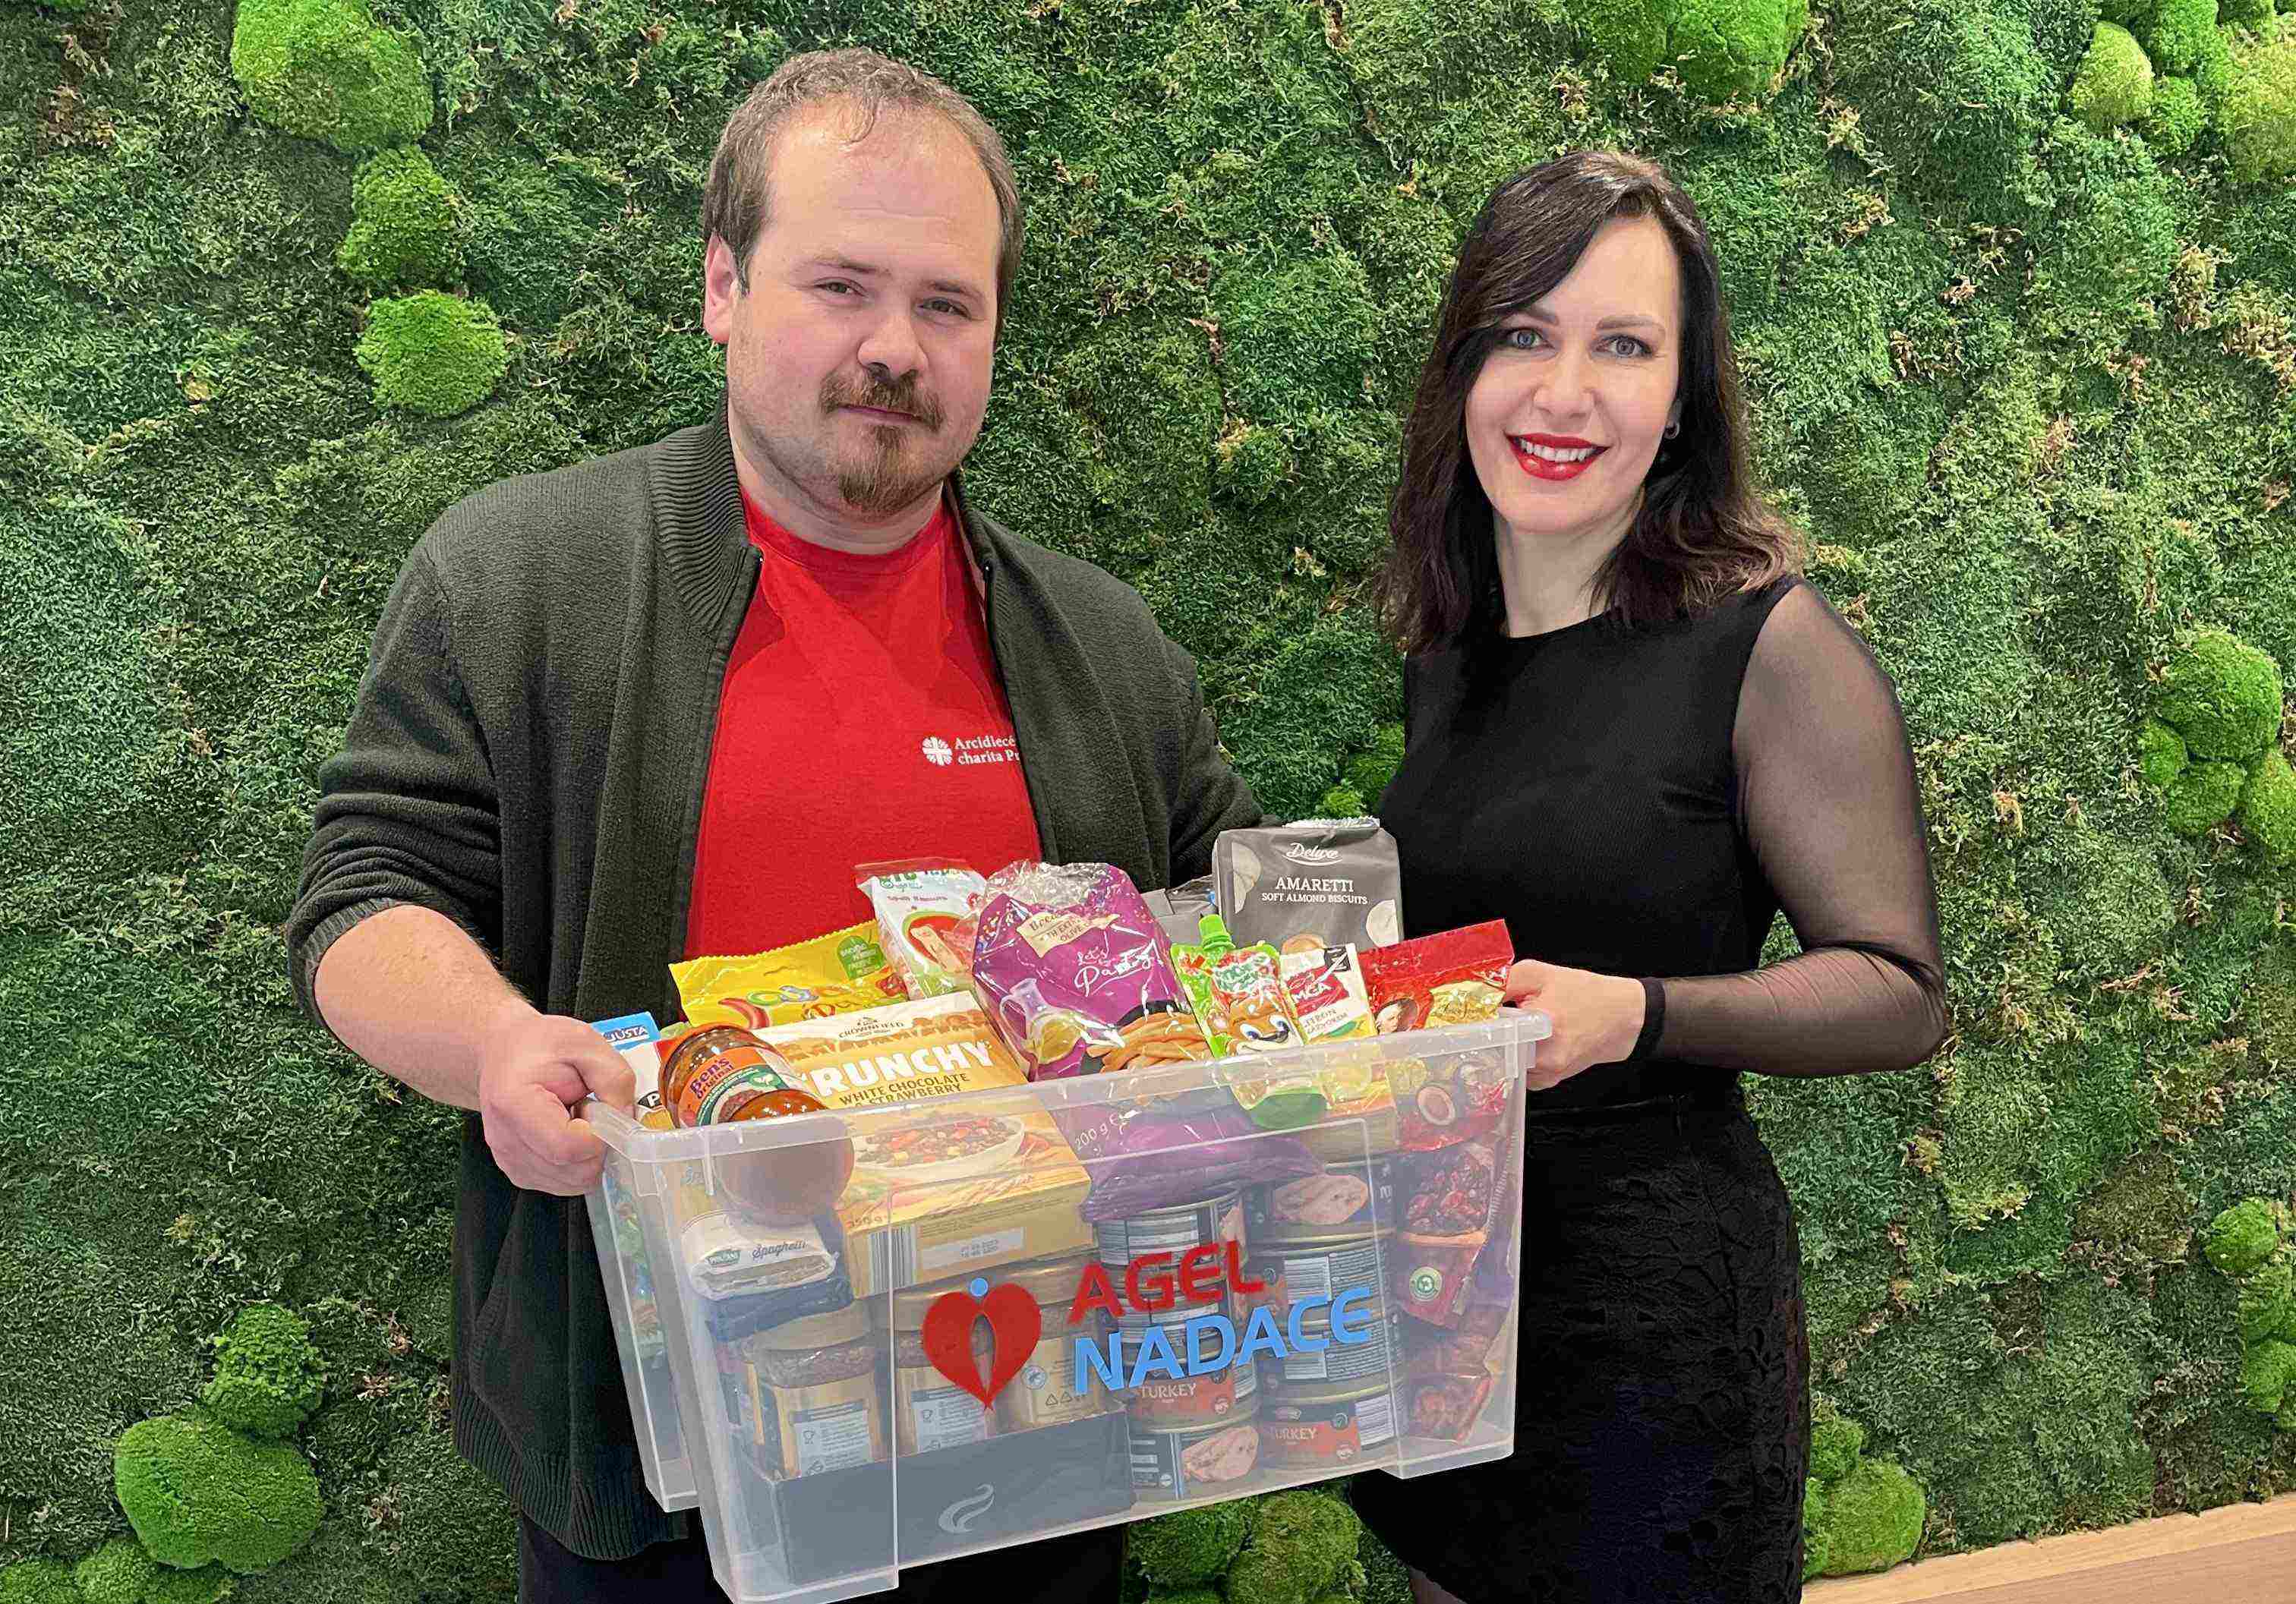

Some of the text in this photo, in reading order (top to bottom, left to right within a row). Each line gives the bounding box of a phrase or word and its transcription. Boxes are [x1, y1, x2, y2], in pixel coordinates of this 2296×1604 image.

[958, 751, 1004, 765] charita
[1285, 842, 1339, 861] Deluxe
[1275, 877, 1355, 893] AMARETTI
[1261, 892, 1368, 905] SOFT ALMOND BISCUITS
[801, 1041, 994, 1097] RUNCHY
[838, 1073, 971, 1106] WHITE CHOCOLATE
[869, 1082, 963, 1105] STRAWBERRY
[751, 1240, 808, 1259] Spaghetti
[1068, 1240, 1266, 1324] AGEL
[1074, 1287, 1374, 1396] NADACE
[1141, 1382, 1197, 1398] TURKEY
